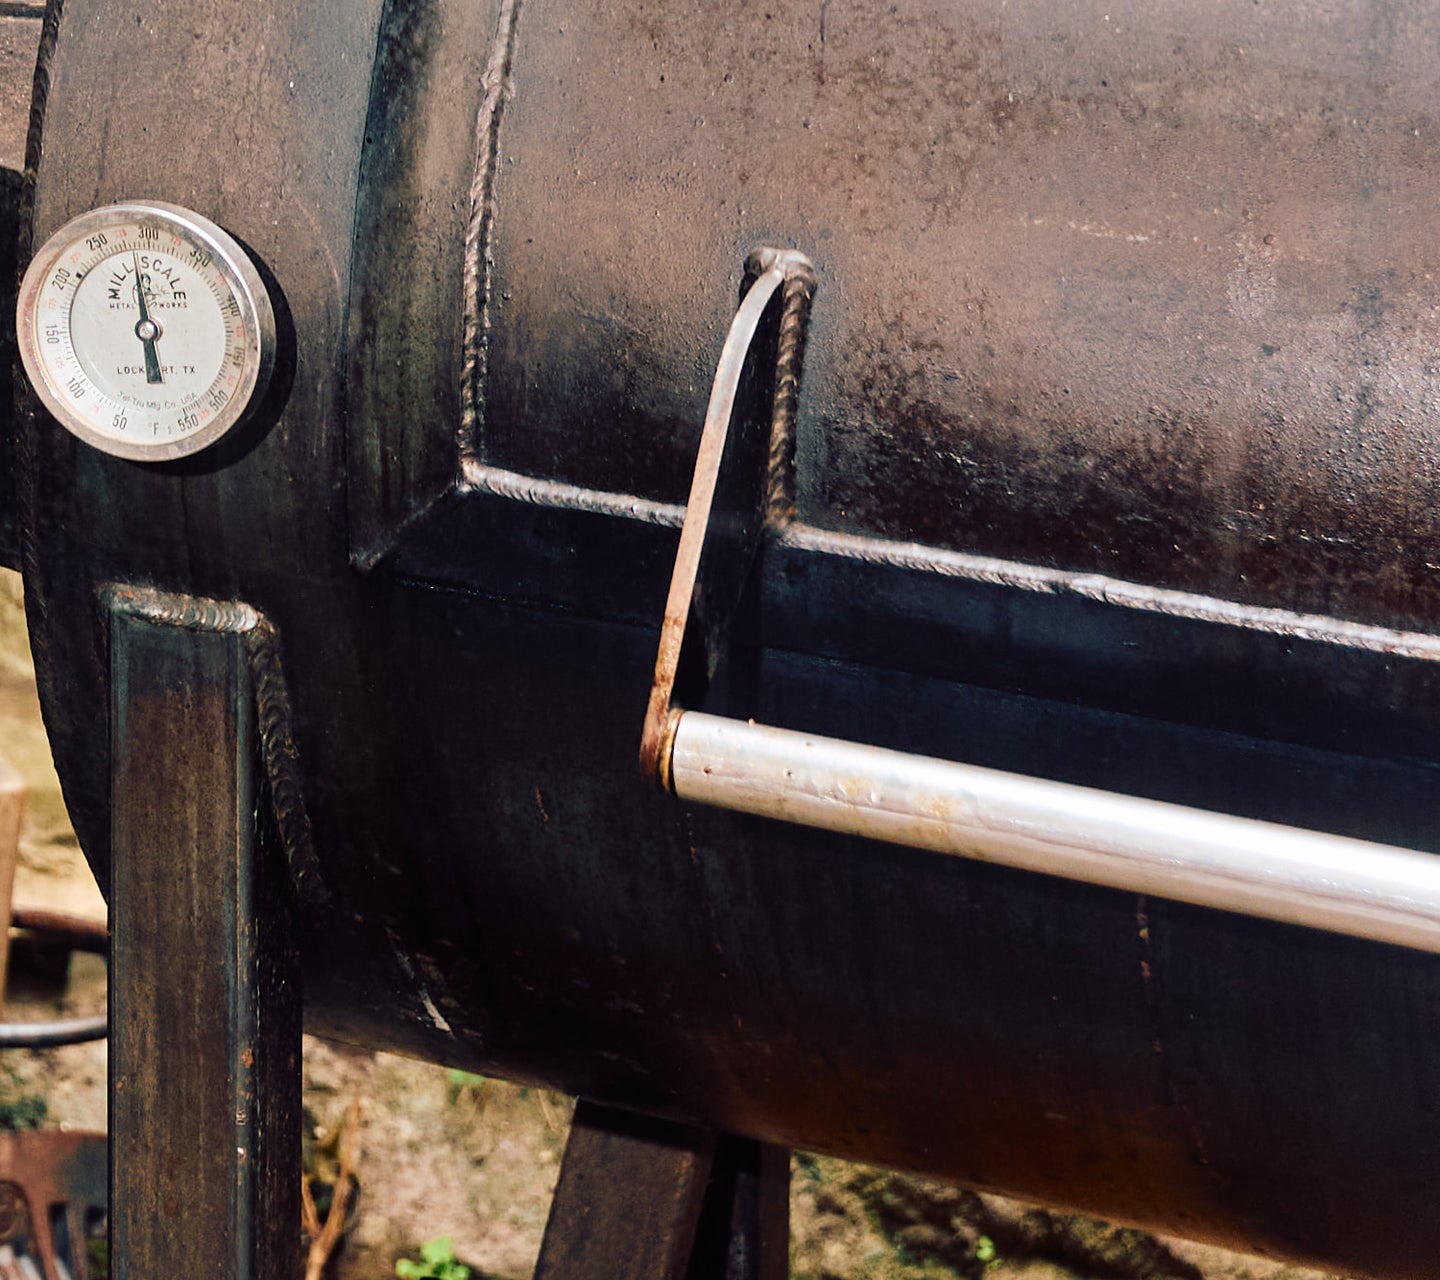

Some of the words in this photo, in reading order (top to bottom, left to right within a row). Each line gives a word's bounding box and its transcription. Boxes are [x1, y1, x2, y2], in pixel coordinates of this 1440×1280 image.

[86, 233, 108, 251] 250
[138, 226, 159, 240] 300
[52, 268, 71, 291] 200
[108, 261, 134, 300] MILL
[141, 256, 187, 300] SCALE
[46, 324, 60, 344] 150
[183, 365, 196, 374] TX
[66, 377, 85, 399] 100
[209, 389, 229, 411] 500
[112, 414, 128, 430] 50
[177, 414, 199, 432] 550
